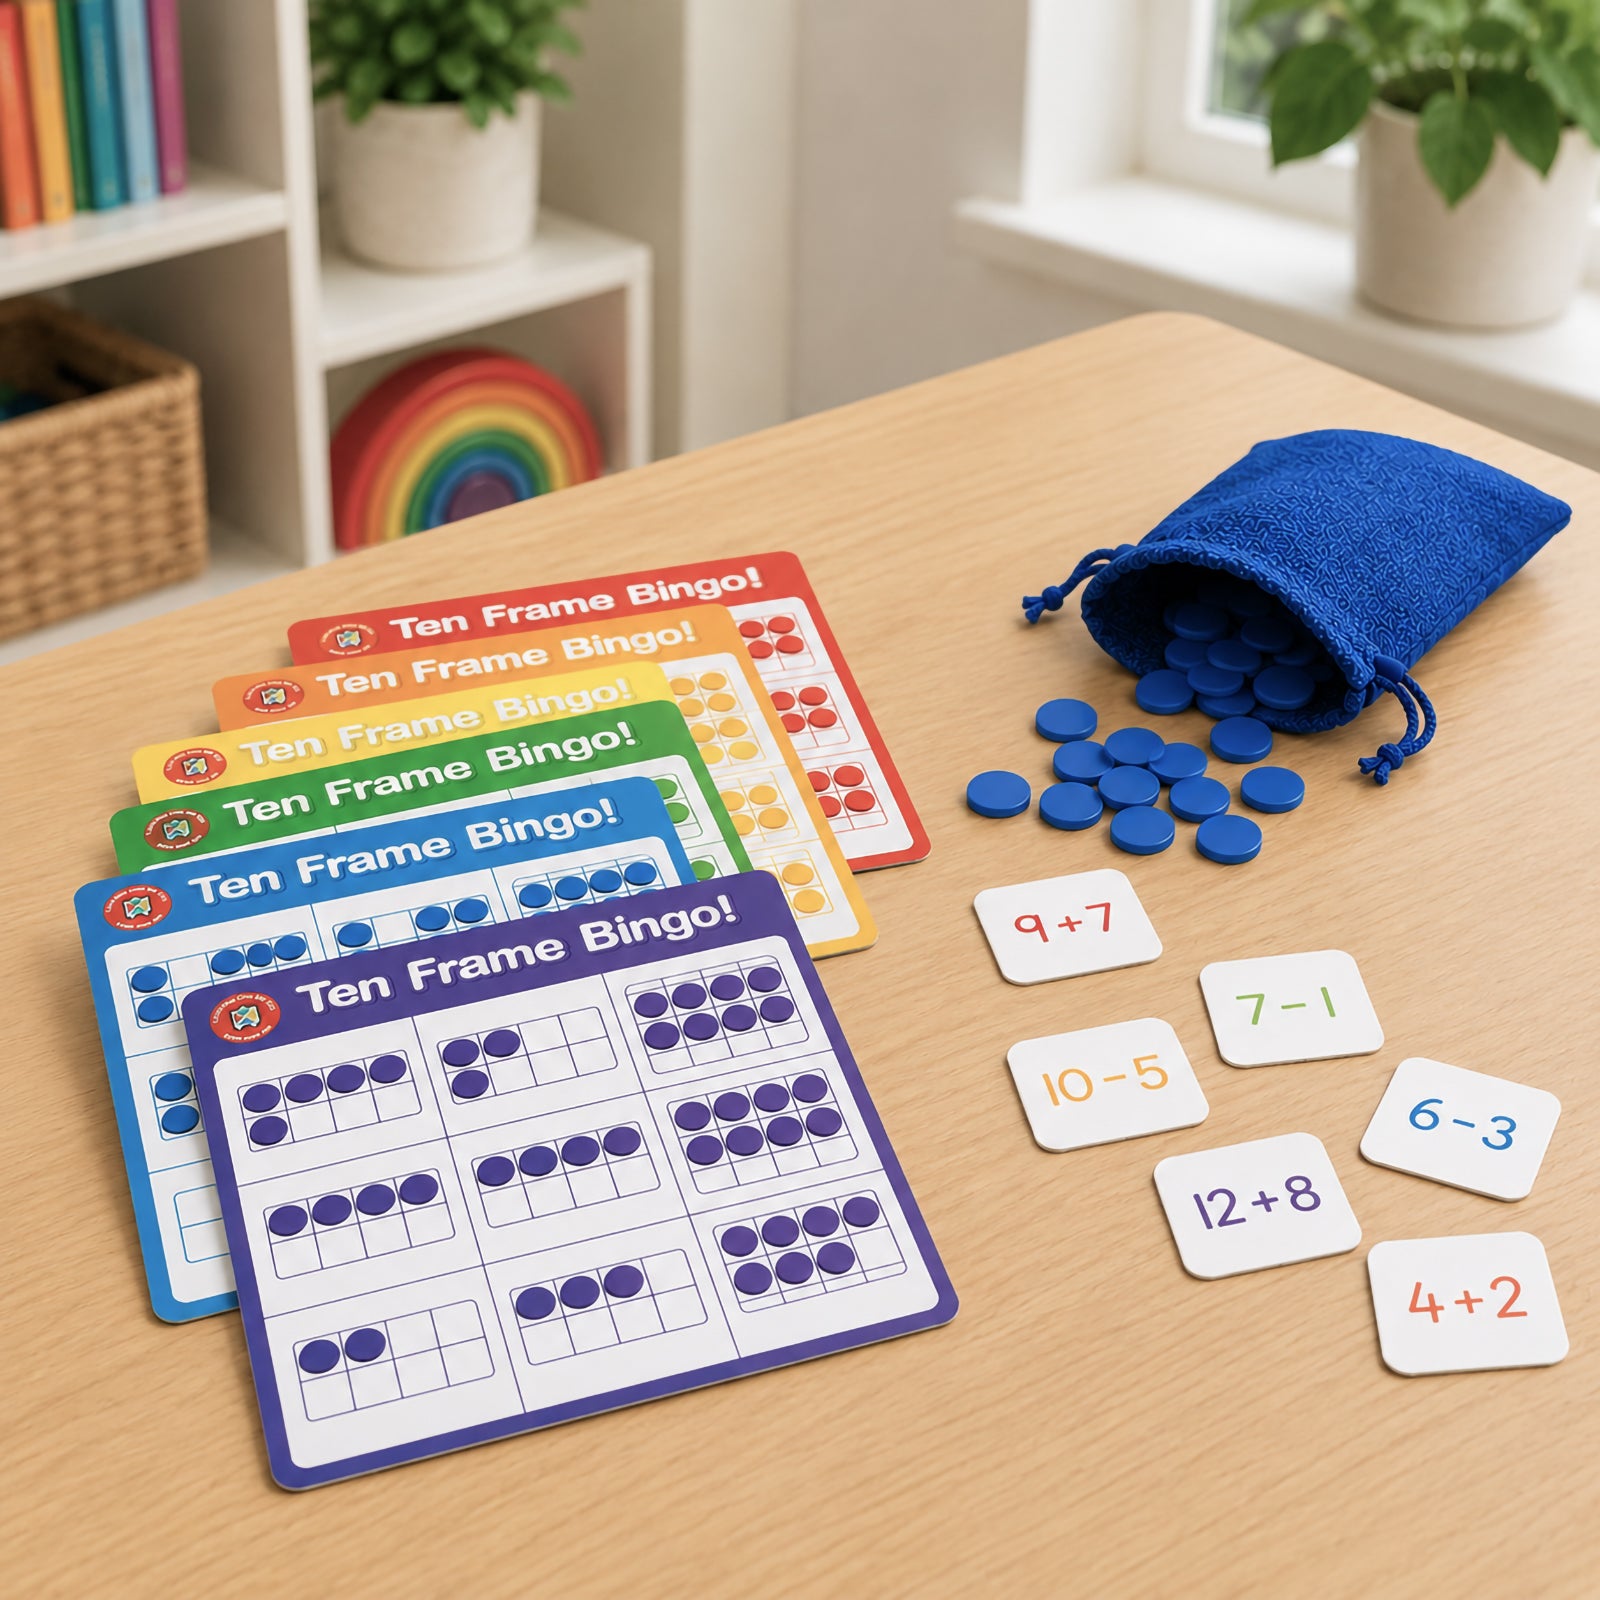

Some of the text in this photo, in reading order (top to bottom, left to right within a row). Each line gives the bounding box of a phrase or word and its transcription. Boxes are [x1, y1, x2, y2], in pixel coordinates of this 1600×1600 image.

[389, 567, 763, 639] Ten Frame Bingo!
[316, 666, 398, 697] Ten
[412, 648, 549, 683] Frame
[561, 620, 697, 660] Bingo!
[239, 678, 632, 765] Ten Frame Bingo!
[223, 722, 636, 825] Ten Frame Bingo!
[188, 798, 619, 904] Ten Frame Bingo!
[296, 895, 737, 1014] Ten Frame Bingo!
